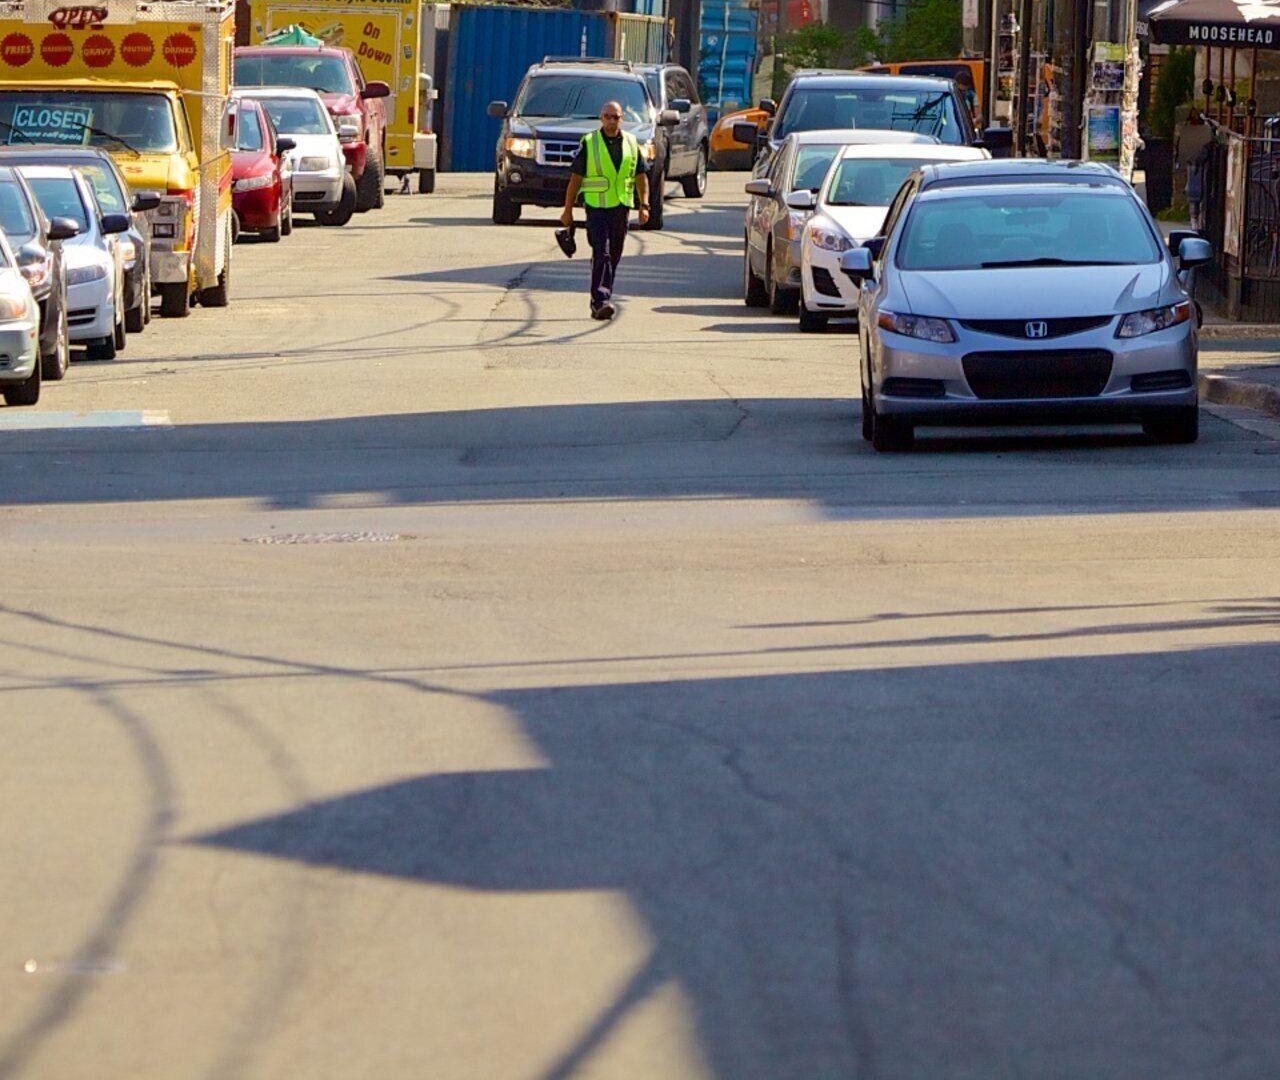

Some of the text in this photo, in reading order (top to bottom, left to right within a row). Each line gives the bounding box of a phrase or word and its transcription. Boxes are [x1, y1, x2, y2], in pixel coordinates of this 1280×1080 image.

[363, 21, 381, 40] On
[1189, 25, 1272, 44] MOOSEHEAD
[5, 45, 31, 54] FRIES
[83, 48, 112, 56] GRAVY
[357, 41, 392, 66] Down
[16, 109, 86, 130] CLOSED
